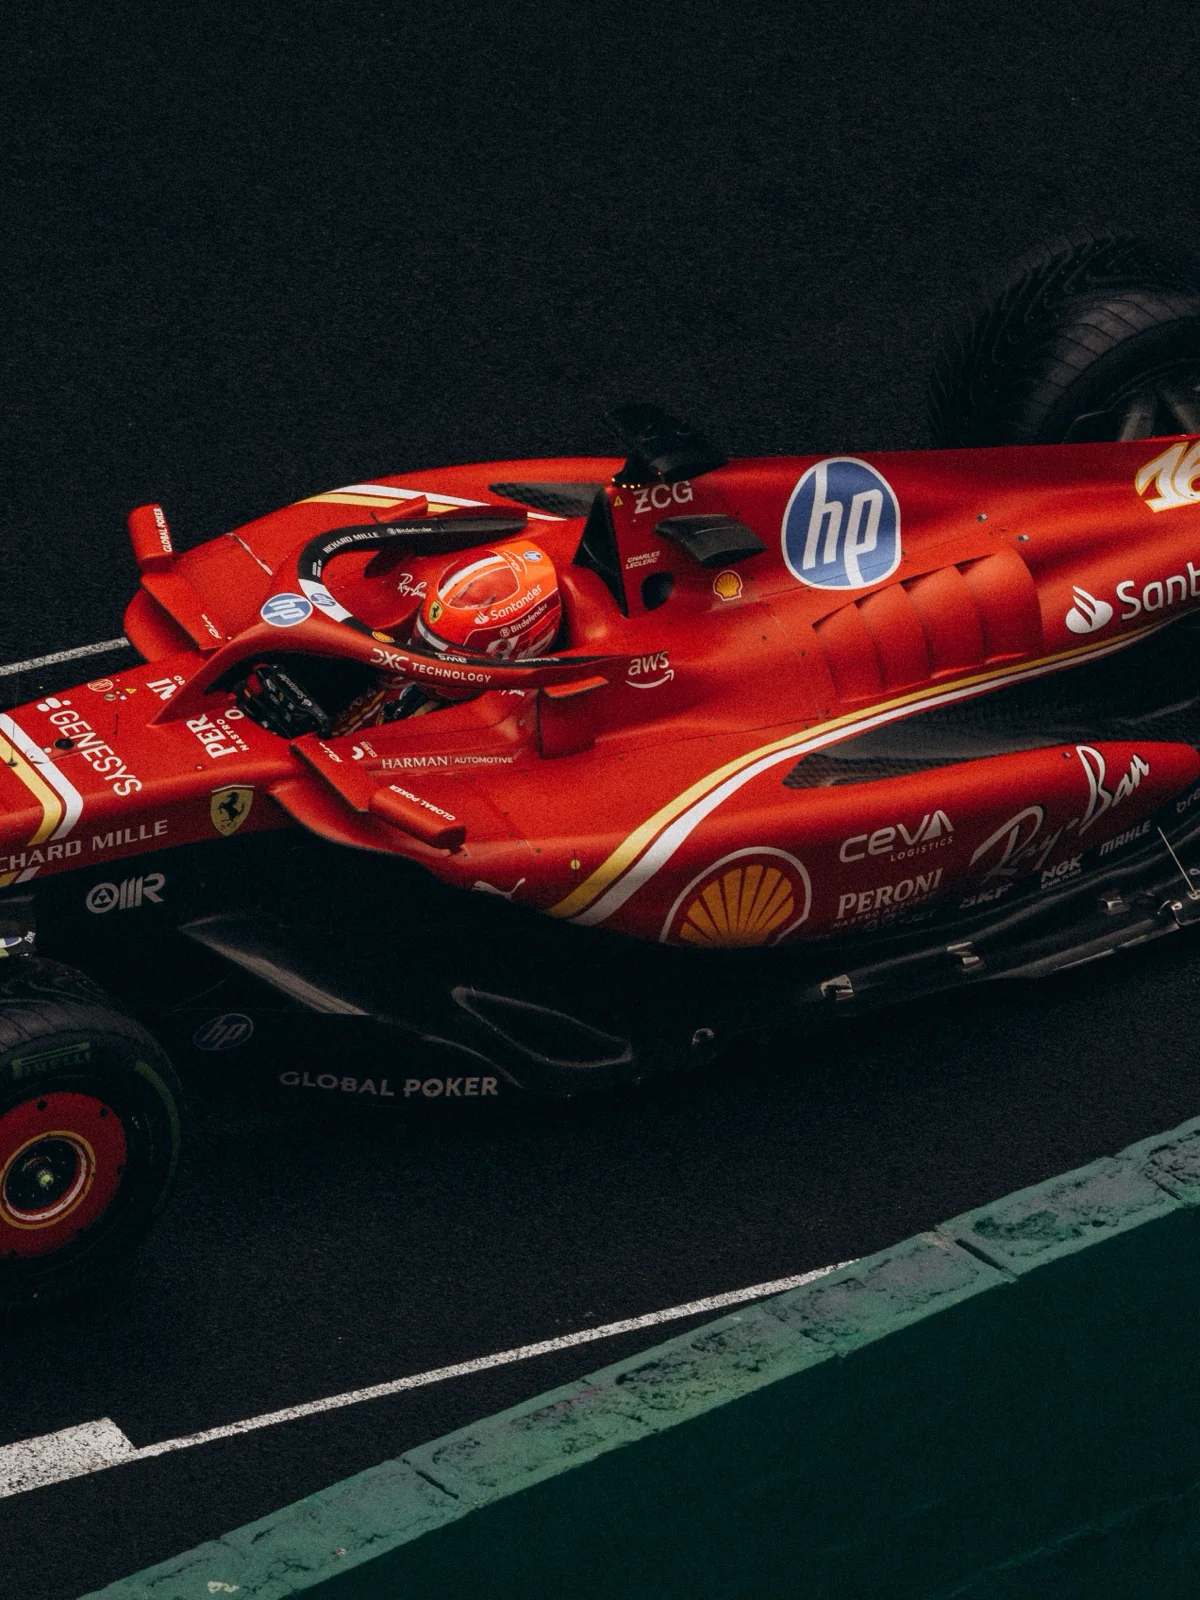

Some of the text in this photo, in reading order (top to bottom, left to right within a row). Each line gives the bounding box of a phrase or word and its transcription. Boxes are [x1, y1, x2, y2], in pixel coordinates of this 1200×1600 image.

[633, 480, 694, 515] ZCG
[801, 462, 887, 588] hp
[158, 528, 173, 553] GLOBAL
[322, 532, 380, 554] RICHARD MILLE
[625, 557, 658, 570] LECLERC
[627, 551, 660, 564] CHARLES
[264, 597, 308, 619] hp
[490, 584, 543, 621] Santander
[510, 602, 548, 633] Bitdefender
[412, 662, 492, 683] TECHNOLOGY
[627, 650, 670, 676] aws
[216, 718, 250, 752] NASTRO
[49, 709, 143, 797] GENESYS
[381, 756, 514, 769] HARMAN AUTOMOTIVE
[389, 784, 456, 821] GLOBAL POKER
[91, 818, 170, 850] MILLE
[890, 835, 953, 862] LOGISTICS
[1099, 820, 1151, 857] MAHLE
[1040, 853, 1084, 883] NGK
[836, 867, 944, 920] PERONI
[200, 1014, 249, 1049] hp
[278, 1070, 499, 1099] GLOBAL POKER
